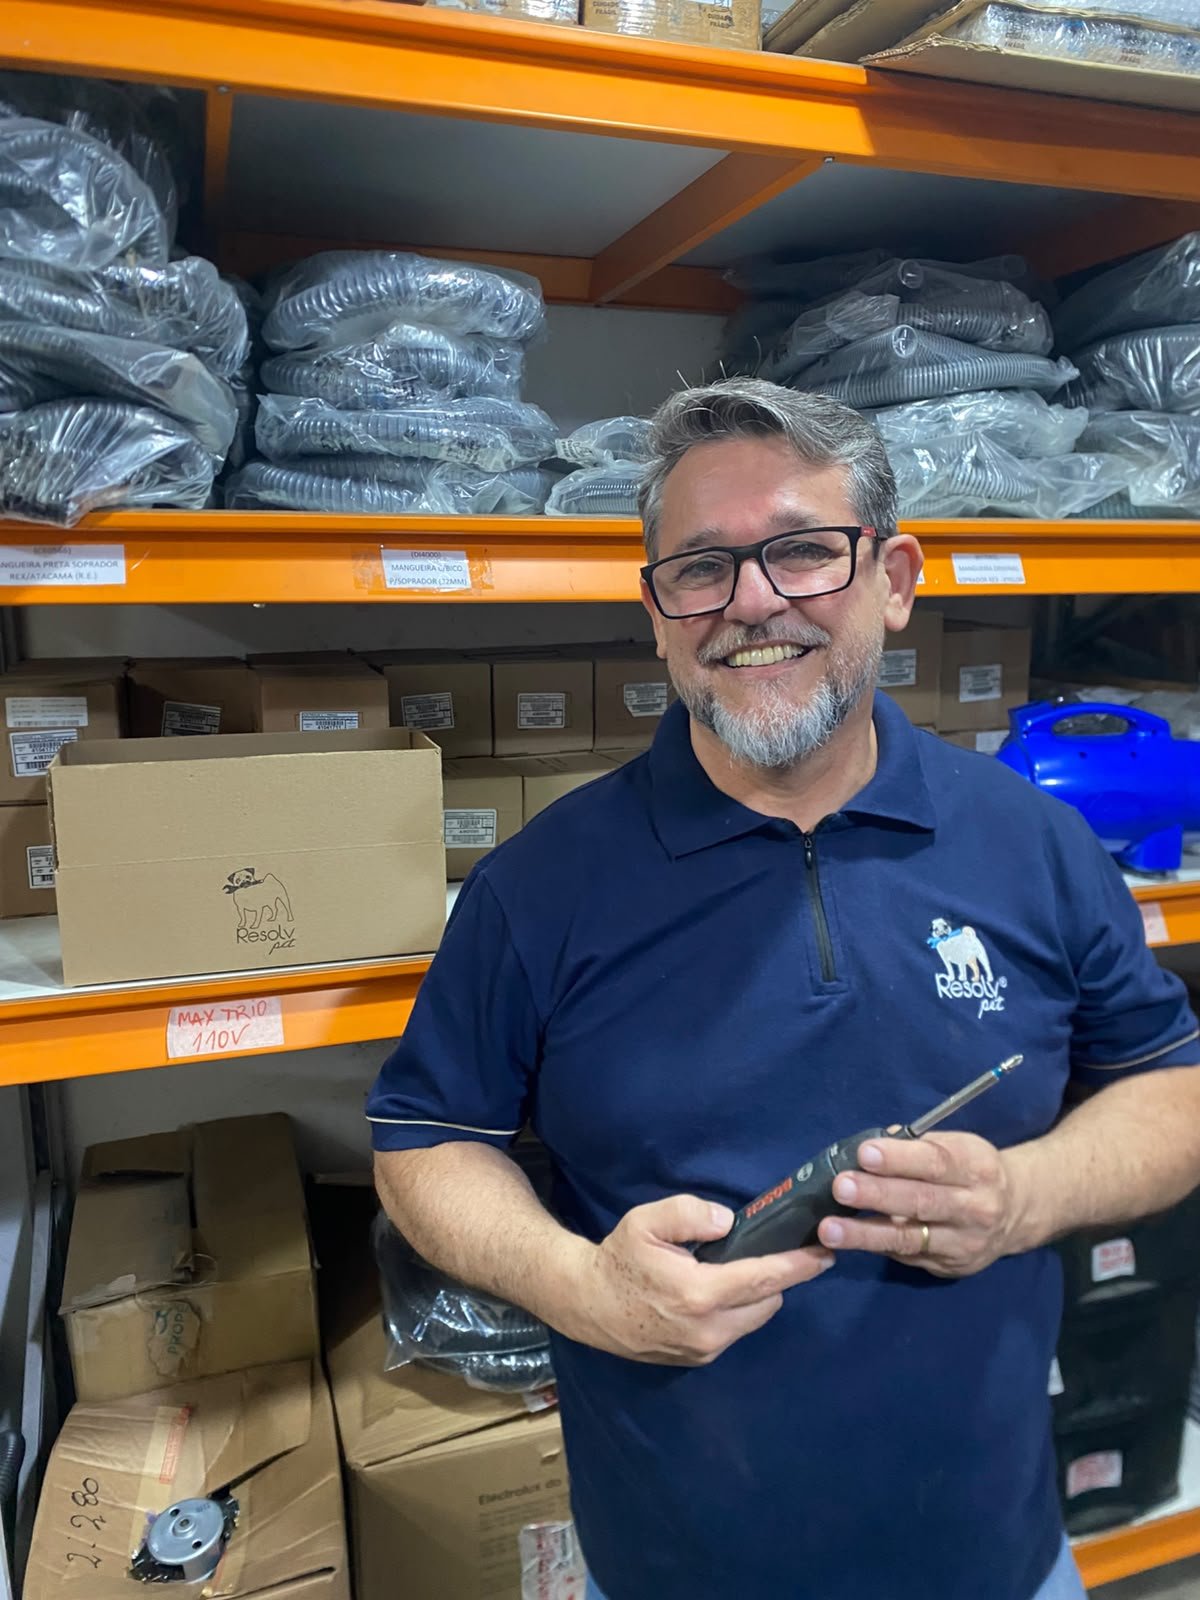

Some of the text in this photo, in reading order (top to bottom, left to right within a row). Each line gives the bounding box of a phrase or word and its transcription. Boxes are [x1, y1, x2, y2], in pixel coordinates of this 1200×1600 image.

[42, 560, 70, 568] PRETA
[72, 560, 118, 568] SOPRADOR
[391, 564, 437, 572] MANGUEIRA
[236, 924, 296, 944] Resolv
[177, 1008, 215, 1028] MAX
[192, 1023, 251, 1053] 110V
